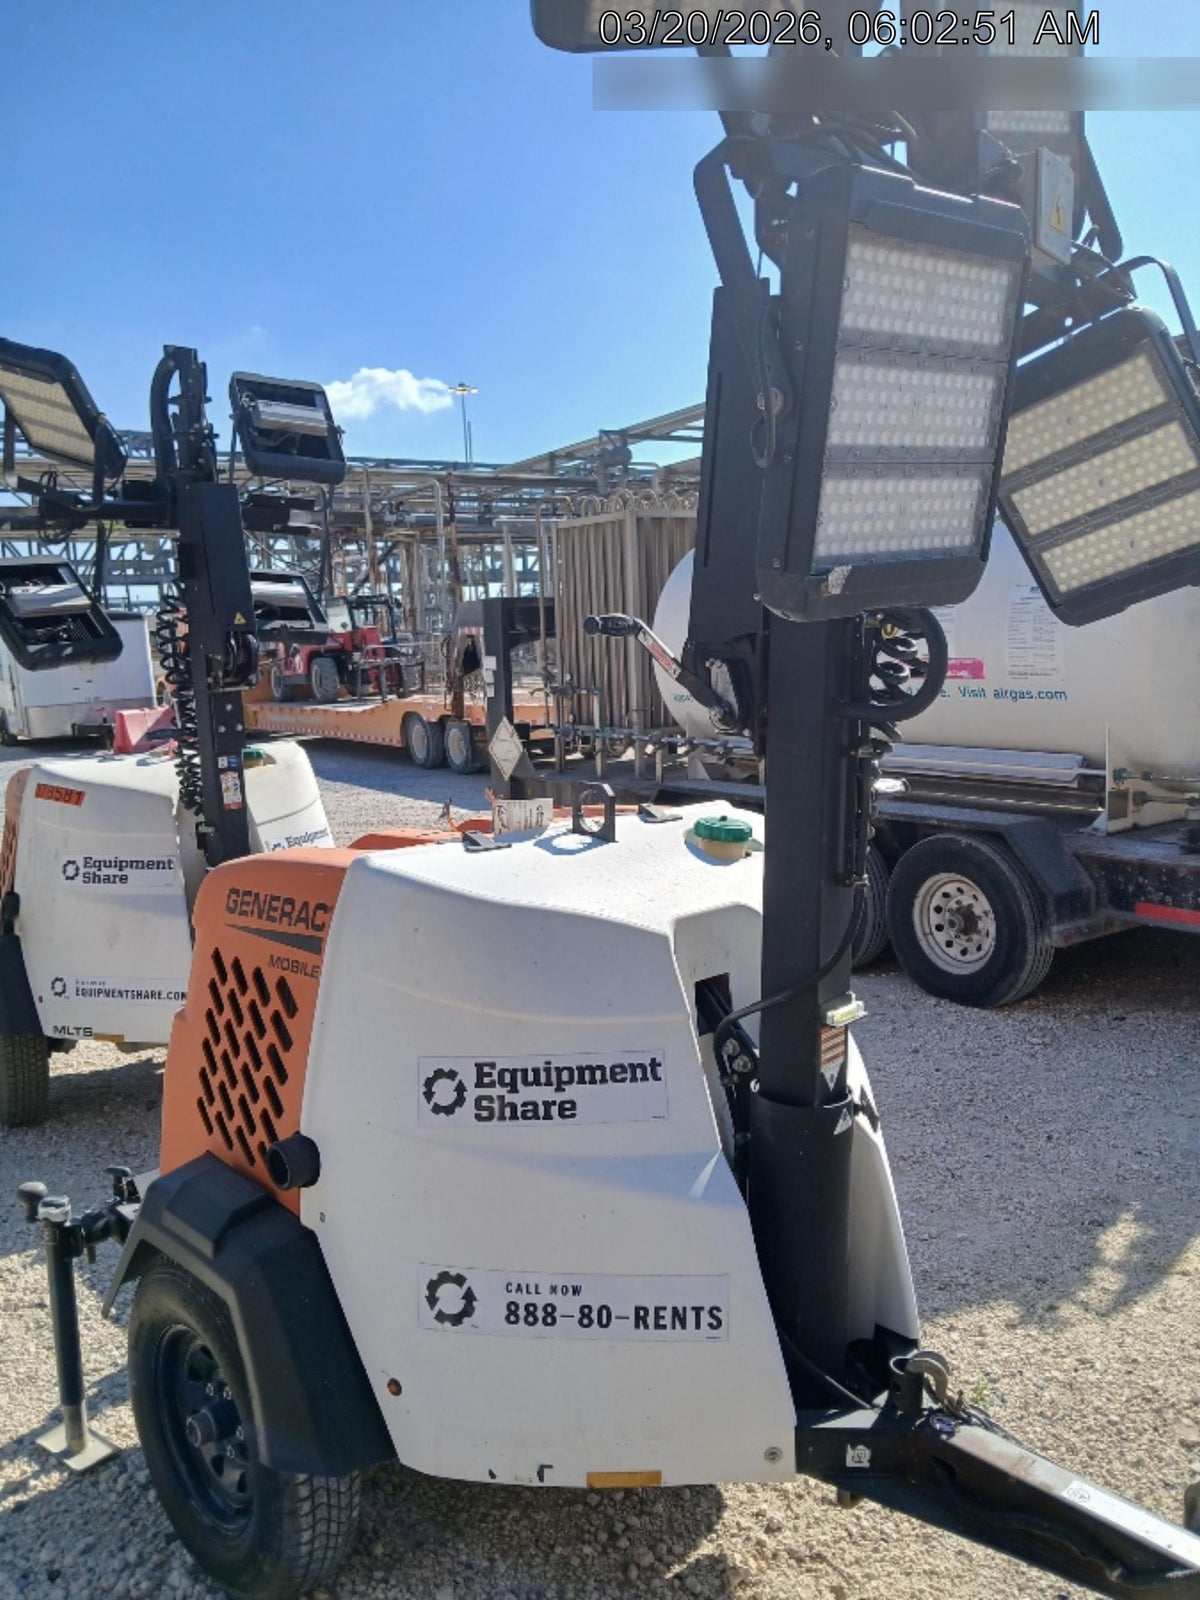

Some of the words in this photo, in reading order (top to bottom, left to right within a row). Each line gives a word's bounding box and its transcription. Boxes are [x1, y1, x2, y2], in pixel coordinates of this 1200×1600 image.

[958, 686, 986, 700] Visit
[993, 687, 1068, 703] airgas.com
[82, 856, 175, 872] Equipment
[82, 871, 129, 885] Share
[225, 887, 329, 933] GENERAC
[267, 953, 321, 980] MOBILE
[474, 1057, 663, 1093] Equipment
[474, 1094, 577, 1123] Share
[505, 1282, 542, 1296] CALL
[550, 1284, 583, 1297] NOW
[504, 1300, 723, 1331] 888-80-RENTS
